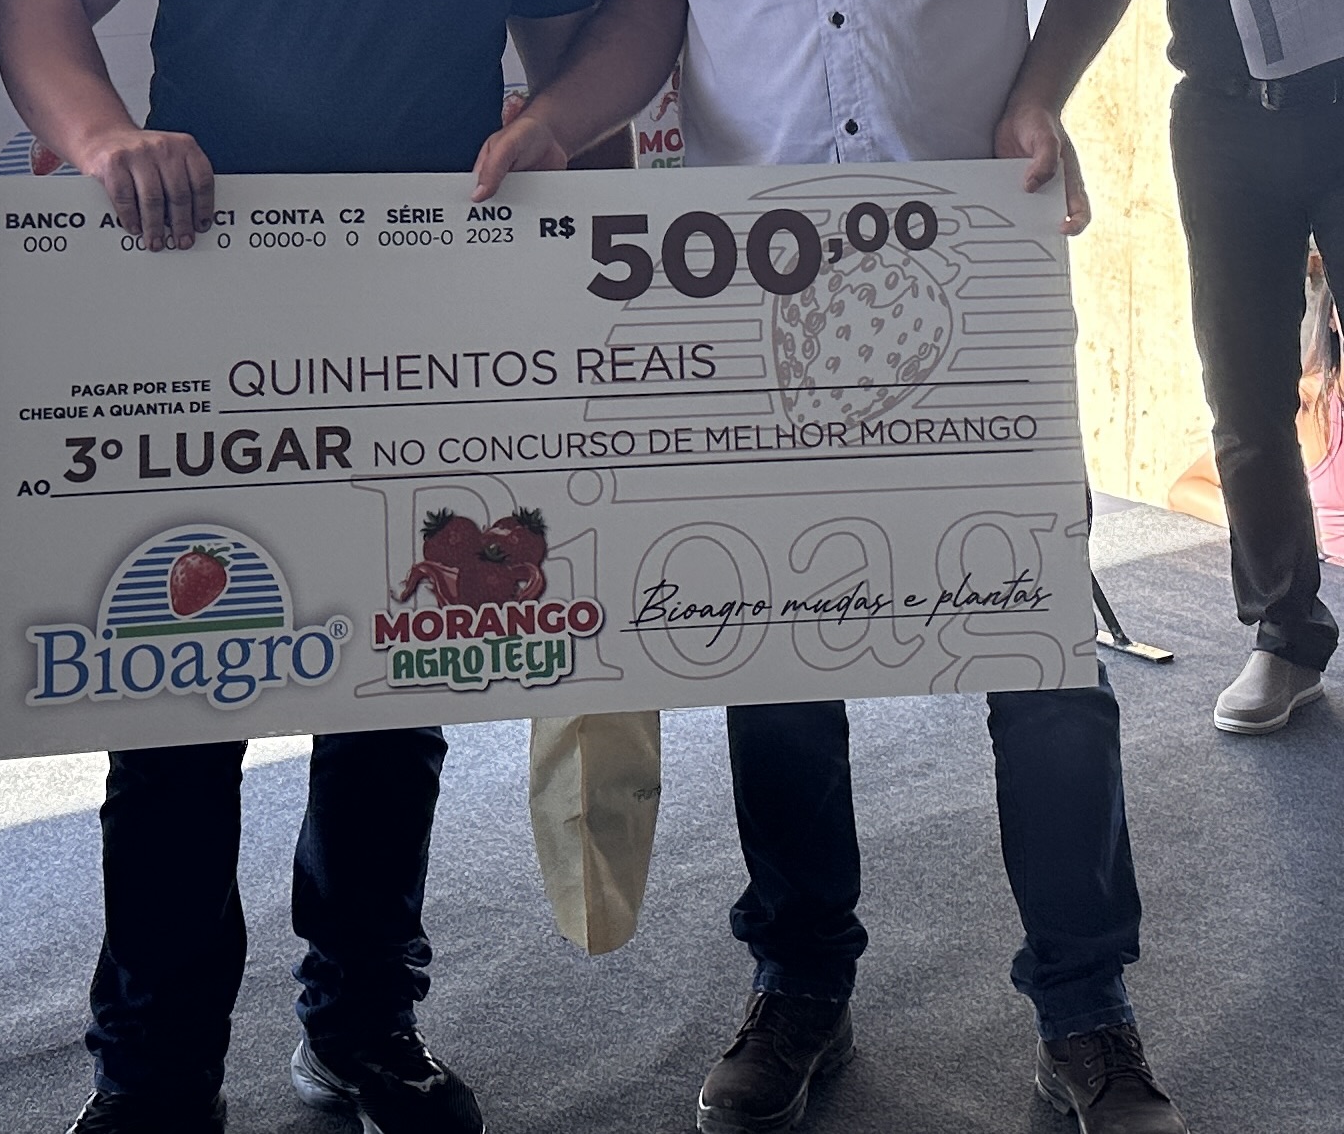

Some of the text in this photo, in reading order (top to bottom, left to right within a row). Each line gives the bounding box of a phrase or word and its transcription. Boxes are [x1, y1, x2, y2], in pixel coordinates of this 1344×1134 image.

[6, 212, 86, 230] BANCO
[213, 210, 236, 226] C1
[250, 209, 325, 226] CONTA
[339, 207, 366, 225] C2
[386, 204, 445, 225] SÉRIE
[466, 205, 513, 222] ANO
[23, 235, 68, 253] 000
[249, 230, 327, 249] 0000-0
[378, 228, 454, 247] 0000-0
[466, 227, 514, 244] 2023
[539, 200, 938, 301] R$ 500,00
[71, 379, 211, 397] PAGAR POR ESTE
[227, 344, 717, 397] QUINHENTOS REAIS
[19, 400, 211, 421] CHEQUE A QUANTIA DE
[17, 479, 51, 497] AO
[139, 425, 353, 480] LUGAR
[373, 440, 424, 467] NO
[438, 429, 636, 463] CONCURSO
[648, 428, 693, 454] DE
[706, 421, 848, 452] MELHOR
[859, 415, 1037, 446] MORANGO
[373, 601, 598, 644] MORANGO
[630, 569, 1053, 647] Bioagro mudas e plantas
[392, 634, 567, 680] AGROTECH
